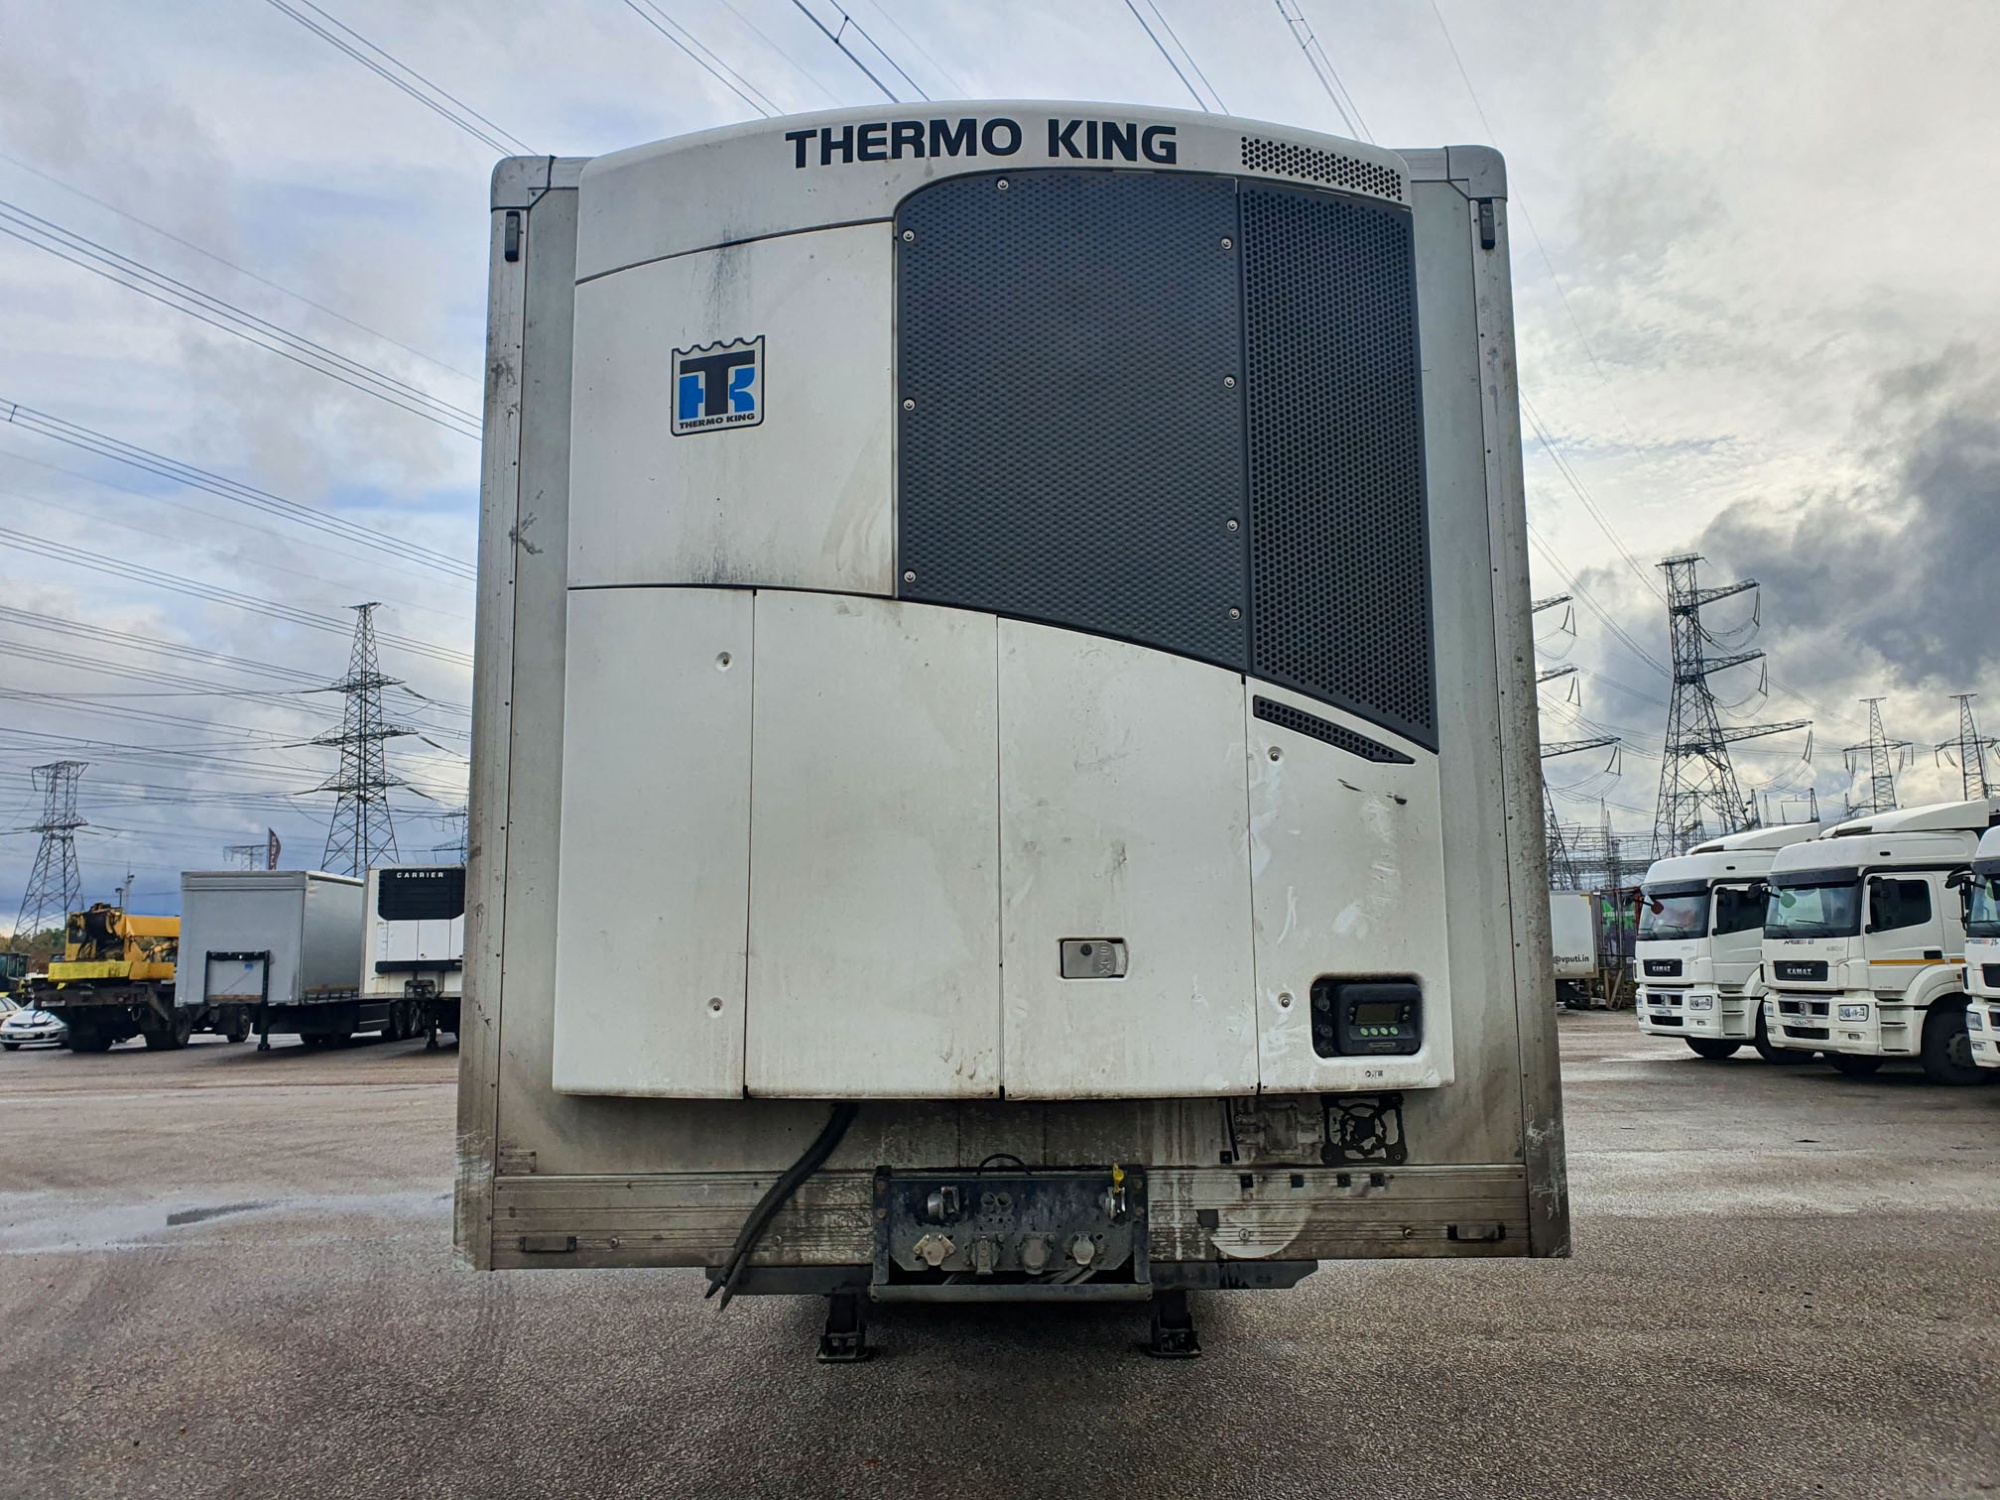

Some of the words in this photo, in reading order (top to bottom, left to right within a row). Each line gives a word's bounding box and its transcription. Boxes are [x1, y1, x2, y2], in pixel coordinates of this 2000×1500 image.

[785, 118, 1022, 169] THERMO
[1048, 119, 1177, 165] KING
[679, 417, 724, 429] THERMO
[726, 412, 755, 423] KING
